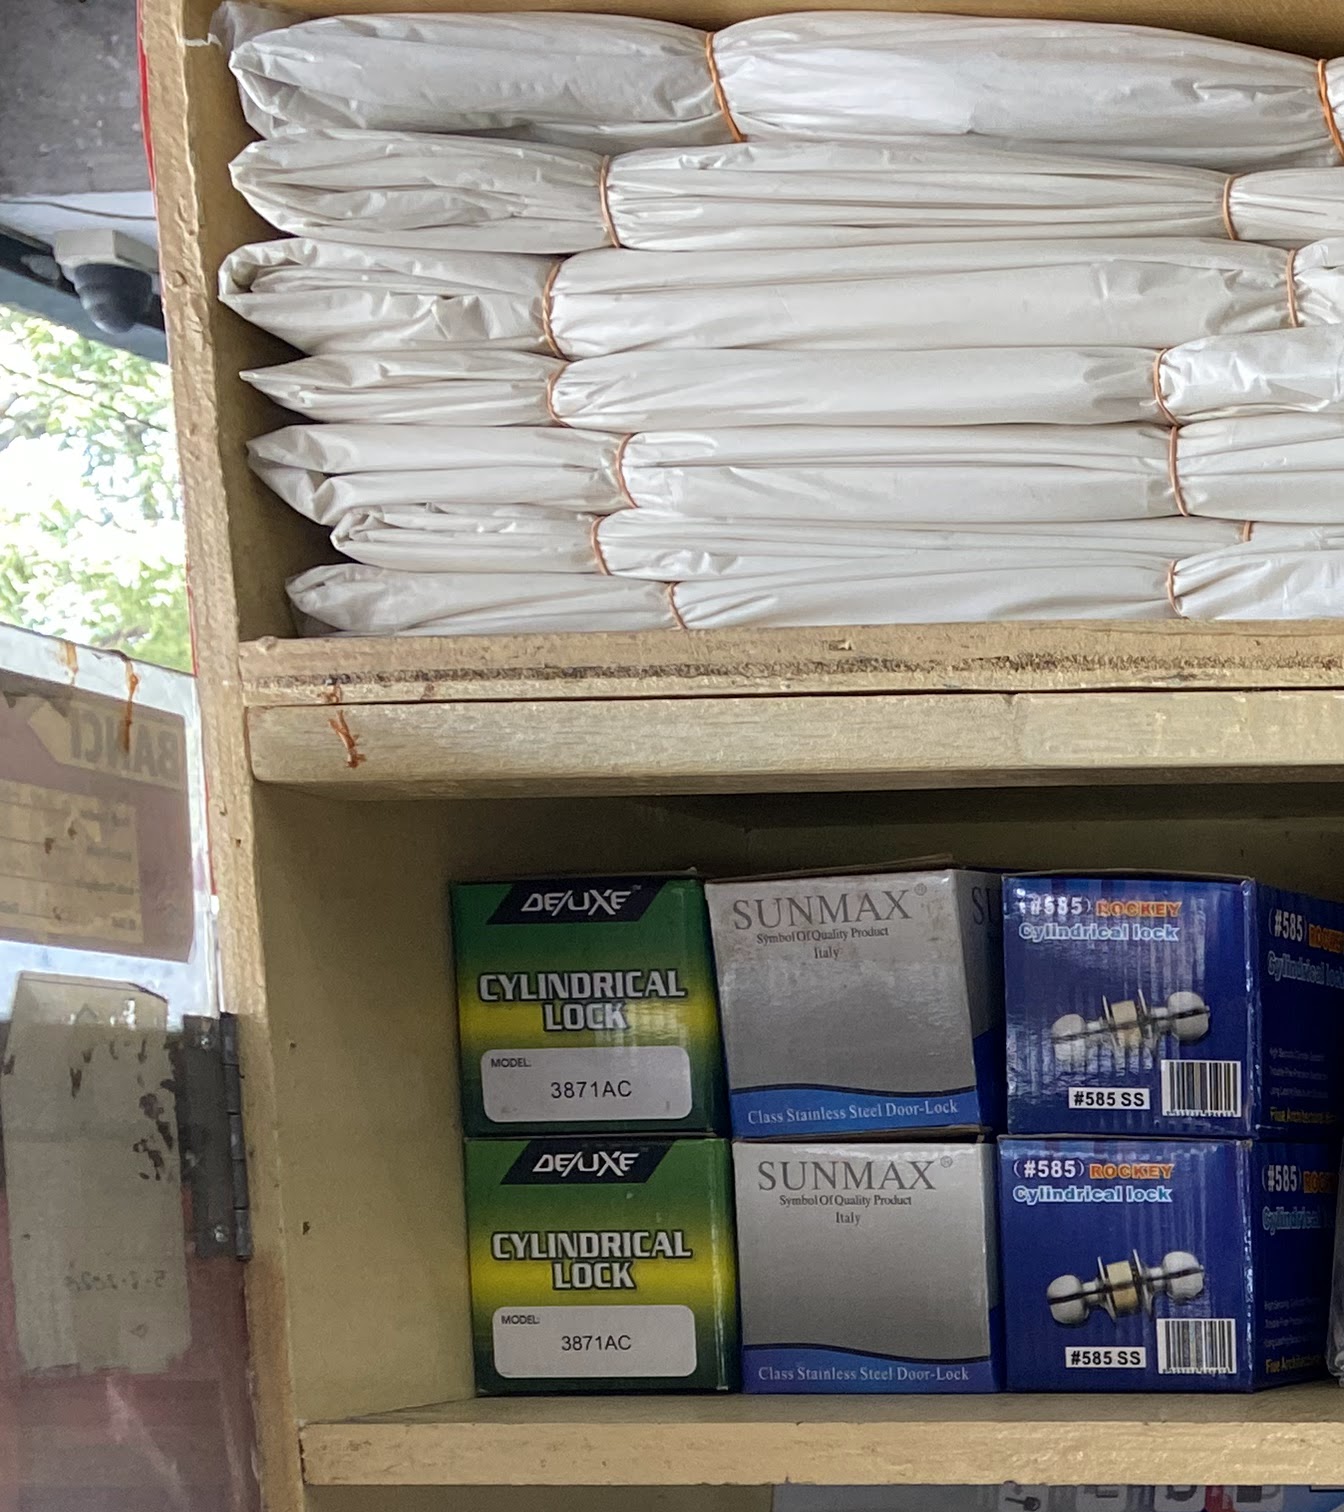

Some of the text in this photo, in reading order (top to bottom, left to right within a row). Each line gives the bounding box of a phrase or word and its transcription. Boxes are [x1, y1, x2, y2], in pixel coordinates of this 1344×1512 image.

[733, 889, 912, 930] SUNMAX
[1096, 900, 1182, 918] ROCKEY
[756, 926, 889, 945] Symbol Of Quality Product
[1019, 923, 1179, 943] Cylindrical lock
[814, 945, 840, 960] Italy
[478, 969, 685, 1001] CYLINDRICAL
[543, 1003, 629, 1031] LOCK
[551, 1080, 632, 1098] 3871AC
[1074, 1091, 1145, 1107] #585 SS
[748, 1099, 958, 1124] Class Stainless Steel Door-Lock
[758, 1159, 936, 1192] SUNMAX
[1012, 1159, 1174, 1179] (#585) ROCKEY
[779, 1194, 912, 1209] Symbol Of Quality Product
[1012, 1185, 1173, 1204] Cylindrical lock
[835, 1211, 861, 1226] Italy
[492, 1231, 692, 1260] CYLINDRICAL
[552, 1262, 634, 1290] LOCK
[561, 1335, 632, 1350] 3871AC
[1071, 1350, 1142, 1366] #585 SS
[758, 1365, 969, 1381] Class Stainless Steel Door-Lock
